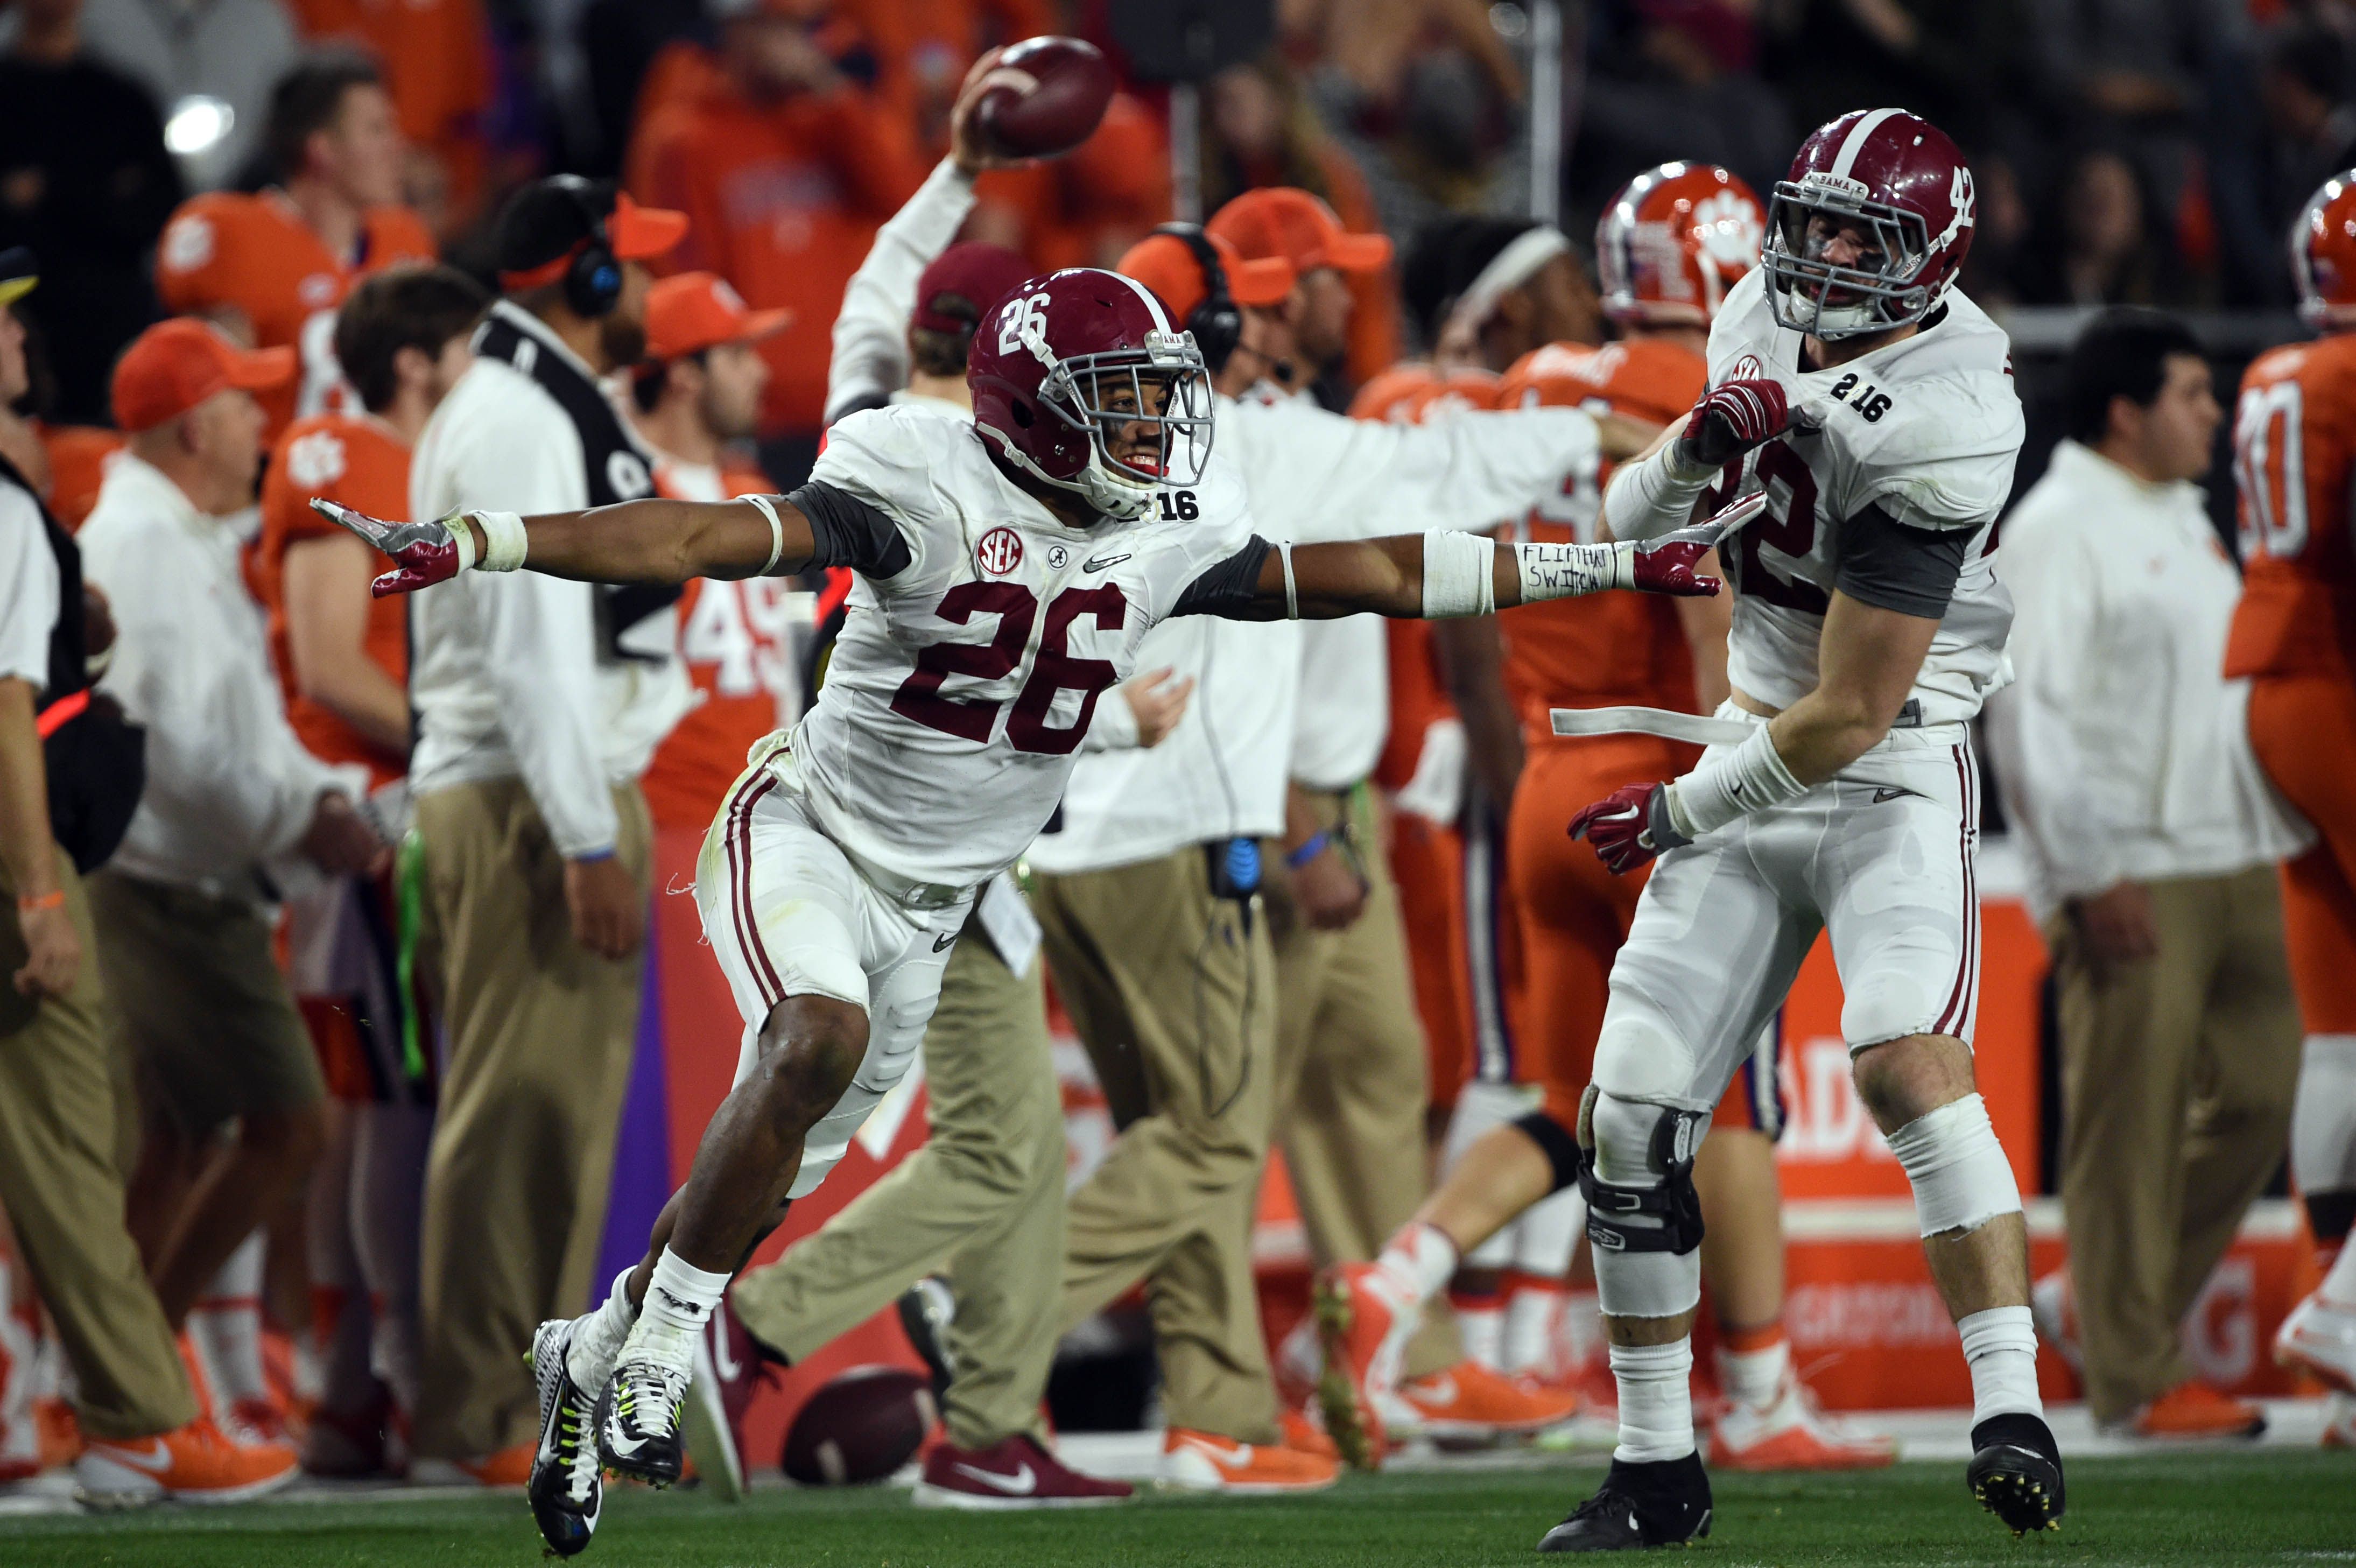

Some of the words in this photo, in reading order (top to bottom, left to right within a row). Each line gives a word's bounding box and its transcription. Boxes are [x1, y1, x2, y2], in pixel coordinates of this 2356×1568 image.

[1819, 175, 1849, 191] BAMA
[1950, 165, 1975, 227] 42
[999, 292, 1051, 356] 26
[981, 530, 1019, 572] SEC
[1524, 545, 1574, 562] FLIP
[1529, 566, 1601, 589] SWITCH
[889, 580, 1127, 754] 26
